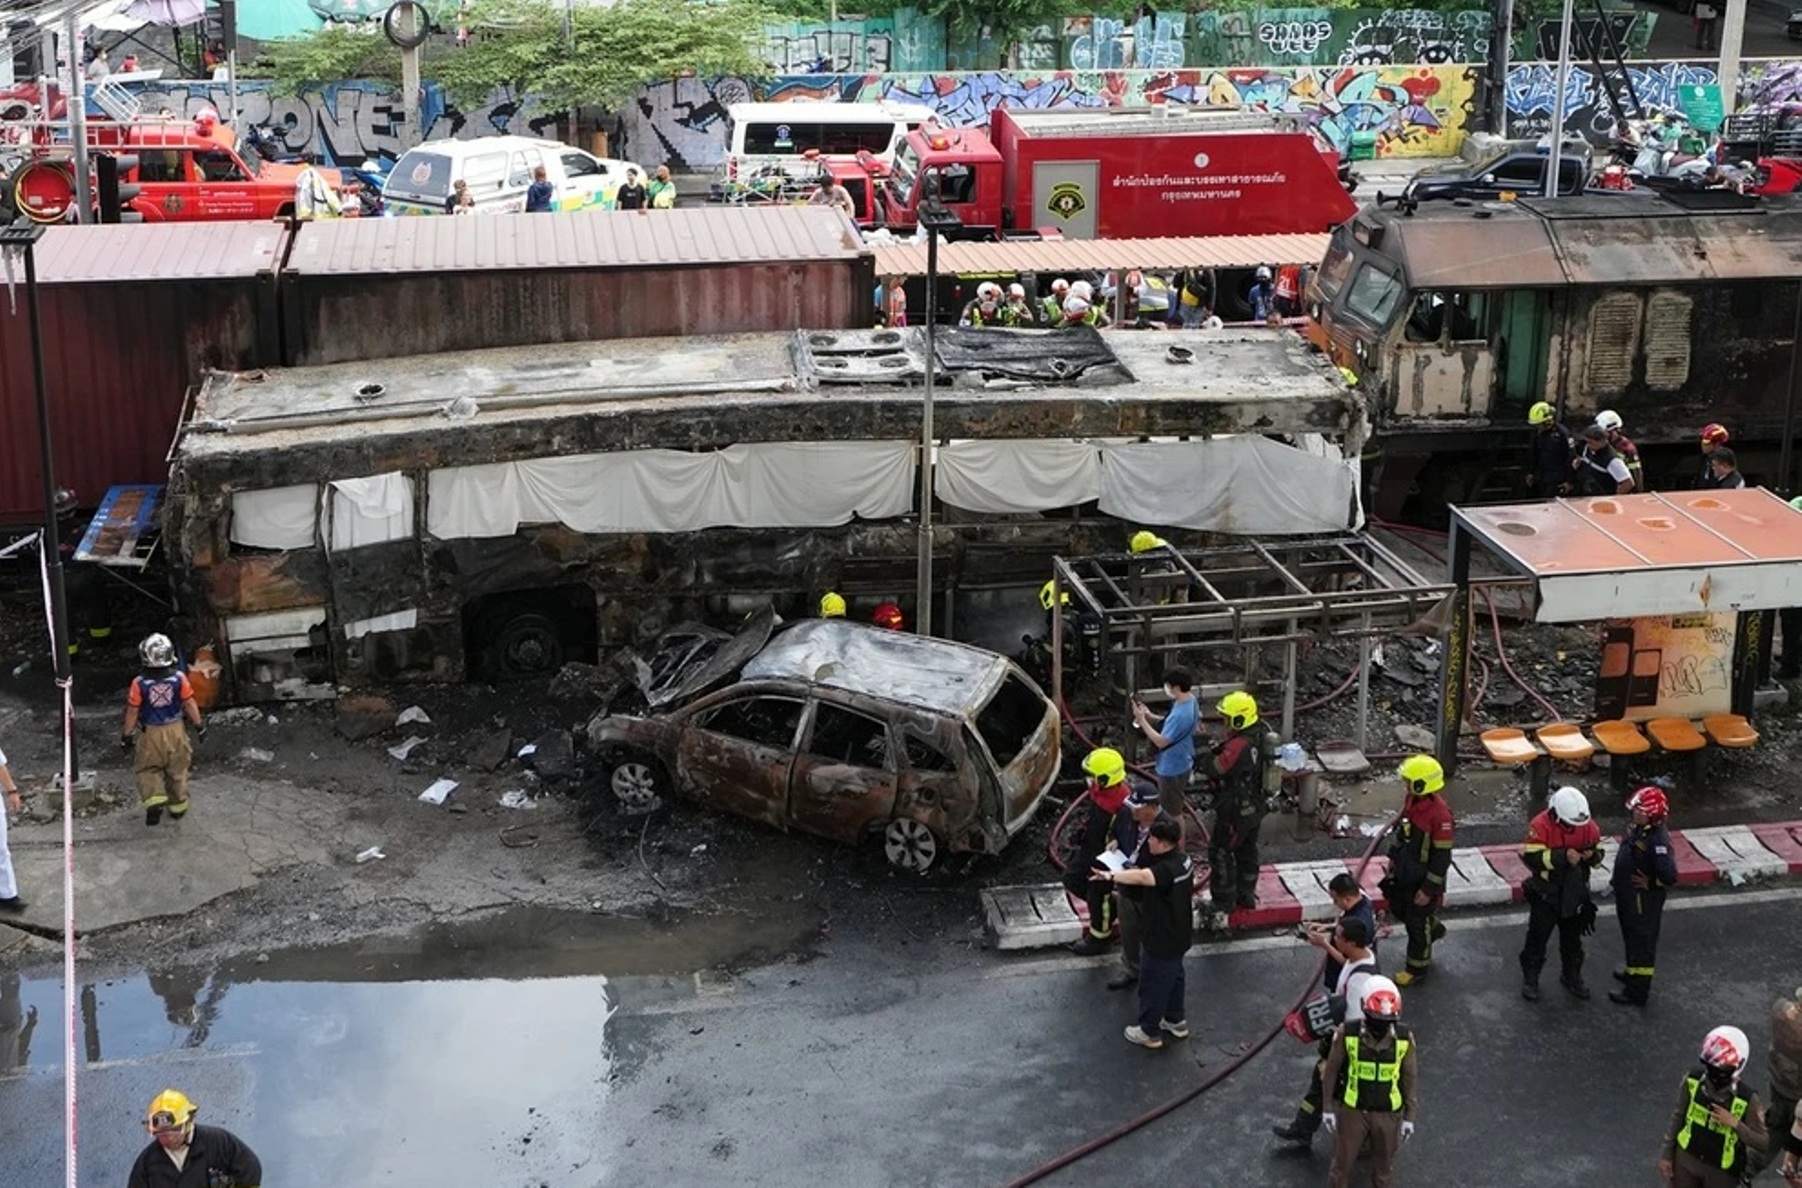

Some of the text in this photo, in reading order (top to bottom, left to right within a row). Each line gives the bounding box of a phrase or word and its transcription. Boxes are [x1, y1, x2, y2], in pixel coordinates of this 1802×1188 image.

[1161, 189, 1242, 204] กรุงเทพมหานคร
